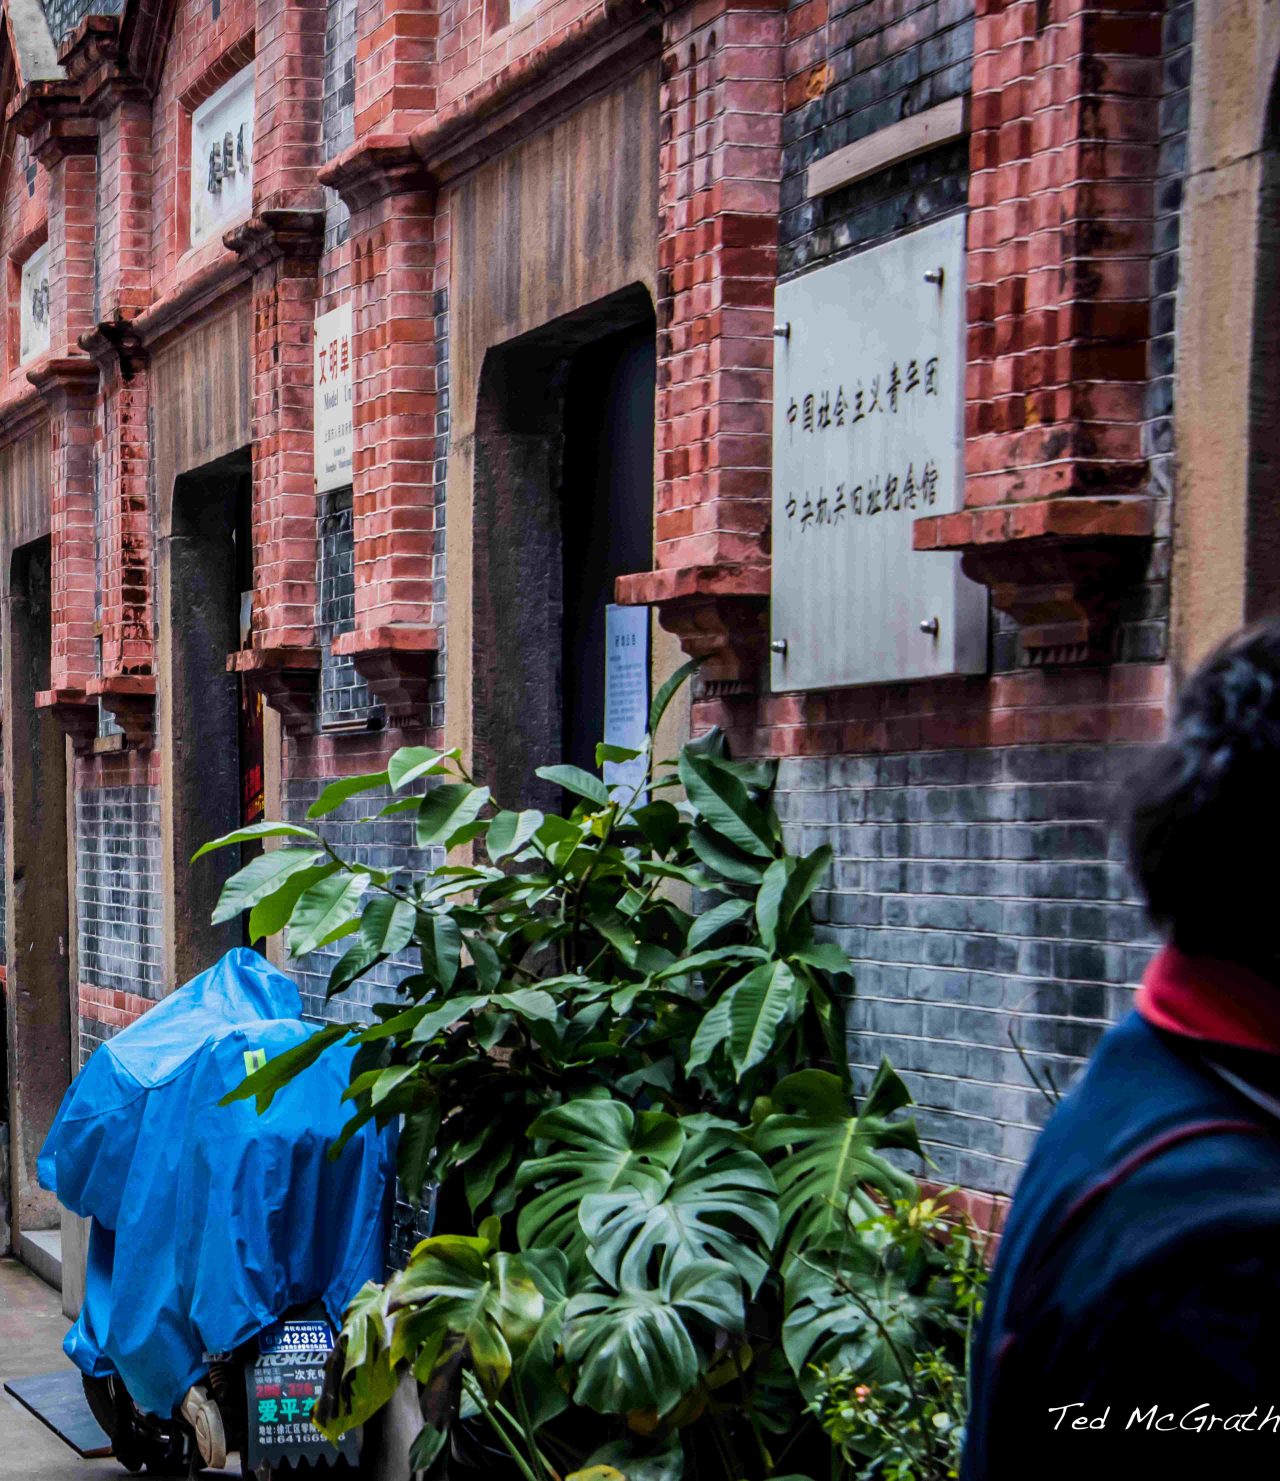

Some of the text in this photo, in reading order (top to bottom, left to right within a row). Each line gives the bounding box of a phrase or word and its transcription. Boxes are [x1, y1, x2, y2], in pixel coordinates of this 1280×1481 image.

[324, 386, 339, 411] Model
[786, 356, 939, 446] 中国社会主义青年团
